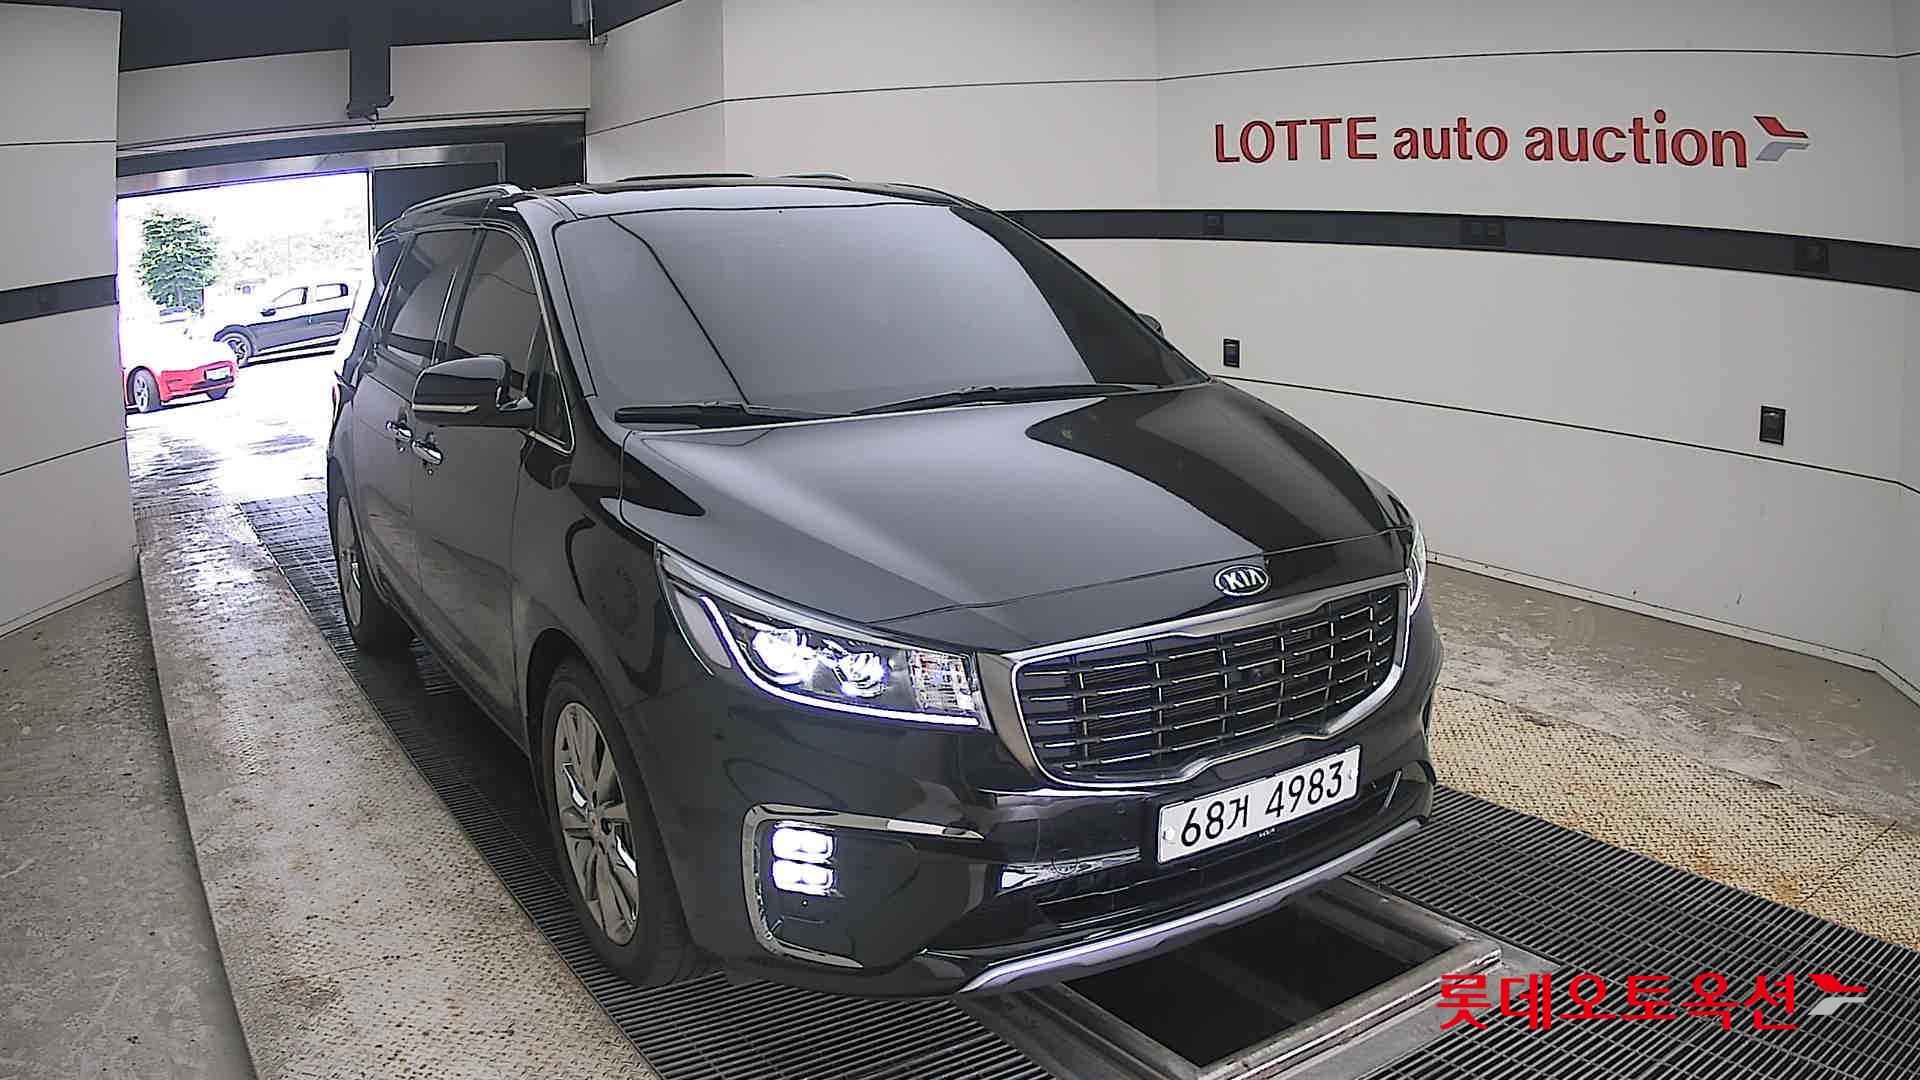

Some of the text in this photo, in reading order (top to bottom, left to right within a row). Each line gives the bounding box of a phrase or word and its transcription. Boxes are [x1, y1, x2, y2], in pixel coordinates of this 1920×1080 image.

[1214, 109, 1748, 168] LOTTE auto auction
[1222, 568, 1265, 591] KIA
[1180, 760, 1344, 847] 68거 4983
